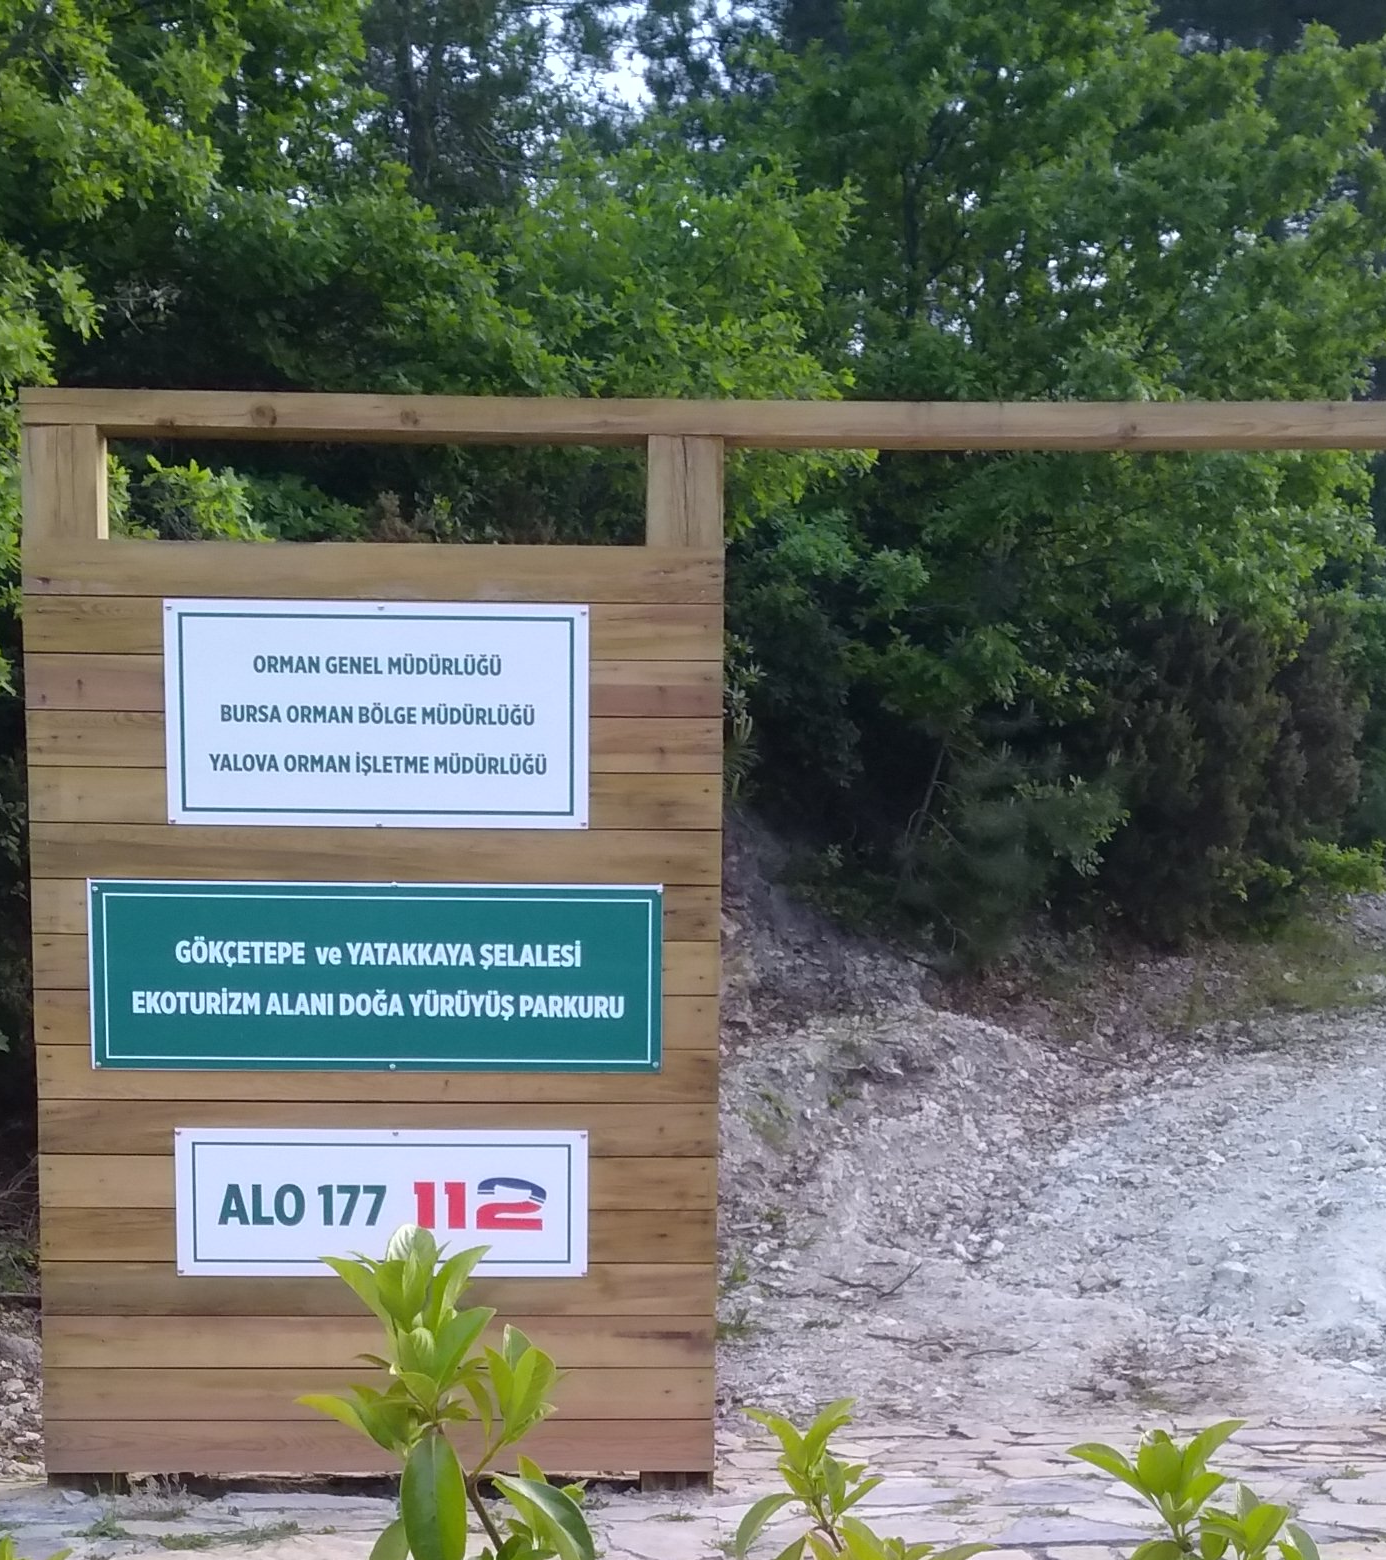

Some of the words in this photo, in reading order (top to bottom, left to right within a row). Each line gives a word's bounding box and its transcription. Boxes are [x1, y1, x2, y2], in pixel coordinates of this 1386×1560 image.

[253, 654, 320, 675] ORMAN
[325, 655, 383, 676] GENEL
[388, 651, 502, 677] MÜDÜRLÜĞÜ
[220, 704, 281, 723] BURSA
[287, 704, 353, 725] ORMAN
[358, 702, 417, 726] BÖLGE
[421, 701, 535, 727] MÜDÜRLÜĞÜ
[209, 753, 280, 773] YALOVA
[283, 753, 351, 774] ORMAN
[355, 751, 429, 777] İŞLETME
[434, 751, 547, 776] MÜDÜRLÜĞÜ
[175, 936, 305, 968] GÖKÇETEPE
[315, 947, 342, 966] ve
[346, 942, 475, 968] YATAKKAYA
[480, 939, 582, 970] ŞELALESİ
[132, 987, 261, 1016] EKOTURİZM
[265, 991, 335, 1017] ALANI
[339, 987, 404, 1018] DOĞA
[409, 989, 514, 1022] YÜRÜYÜŞ
[519, 994, 625, 1019] PARKURU
[217, 1183, 306, 1226] ALO
[317, 1184, 387, 1226] 177
[413, 1177, 547, 1231] 112
